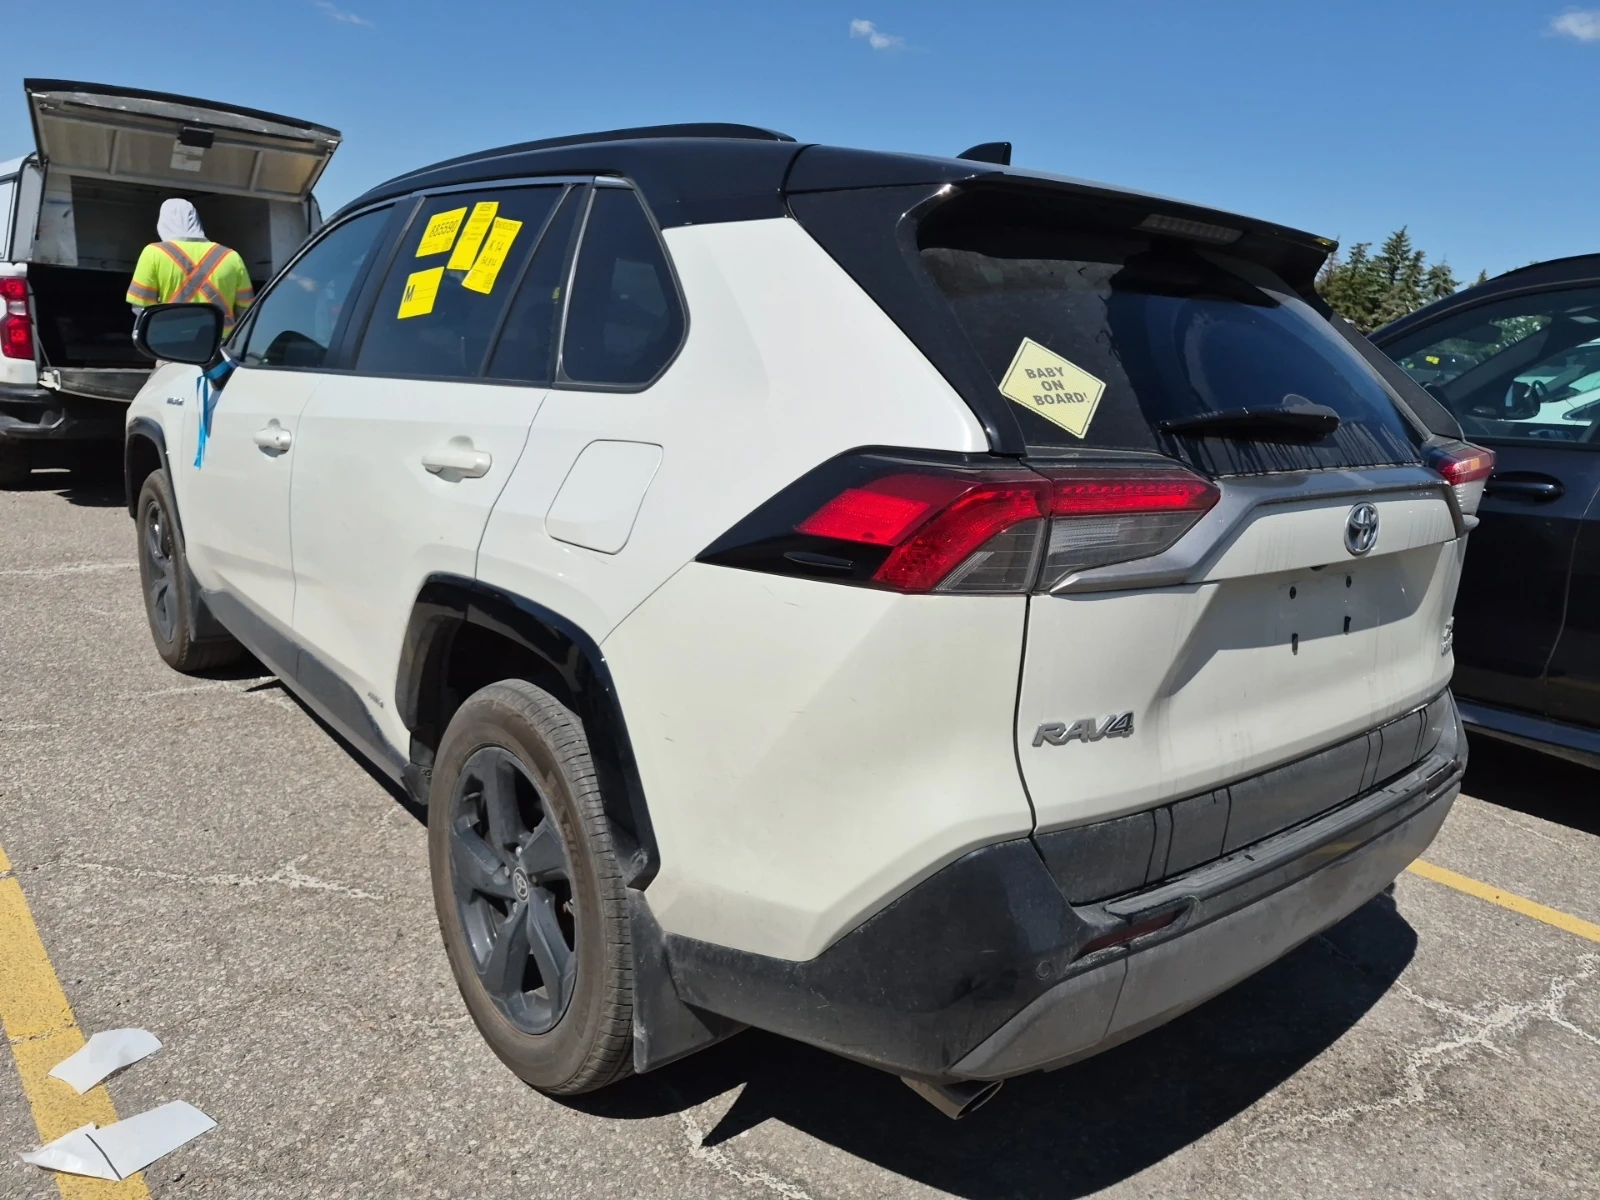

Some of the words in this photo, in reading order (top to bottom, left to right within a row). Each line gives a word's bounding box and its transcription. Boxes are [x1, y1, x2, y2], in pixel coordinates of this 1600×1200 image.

[404, 284, 416, 303] M
[1025, 366, 1064, 379] BABY
[1041, 380, 1065, 391] ON
[1033, 392, 1090, 406] BOARD!
[1032, 710, 1134, 747] RAV4
